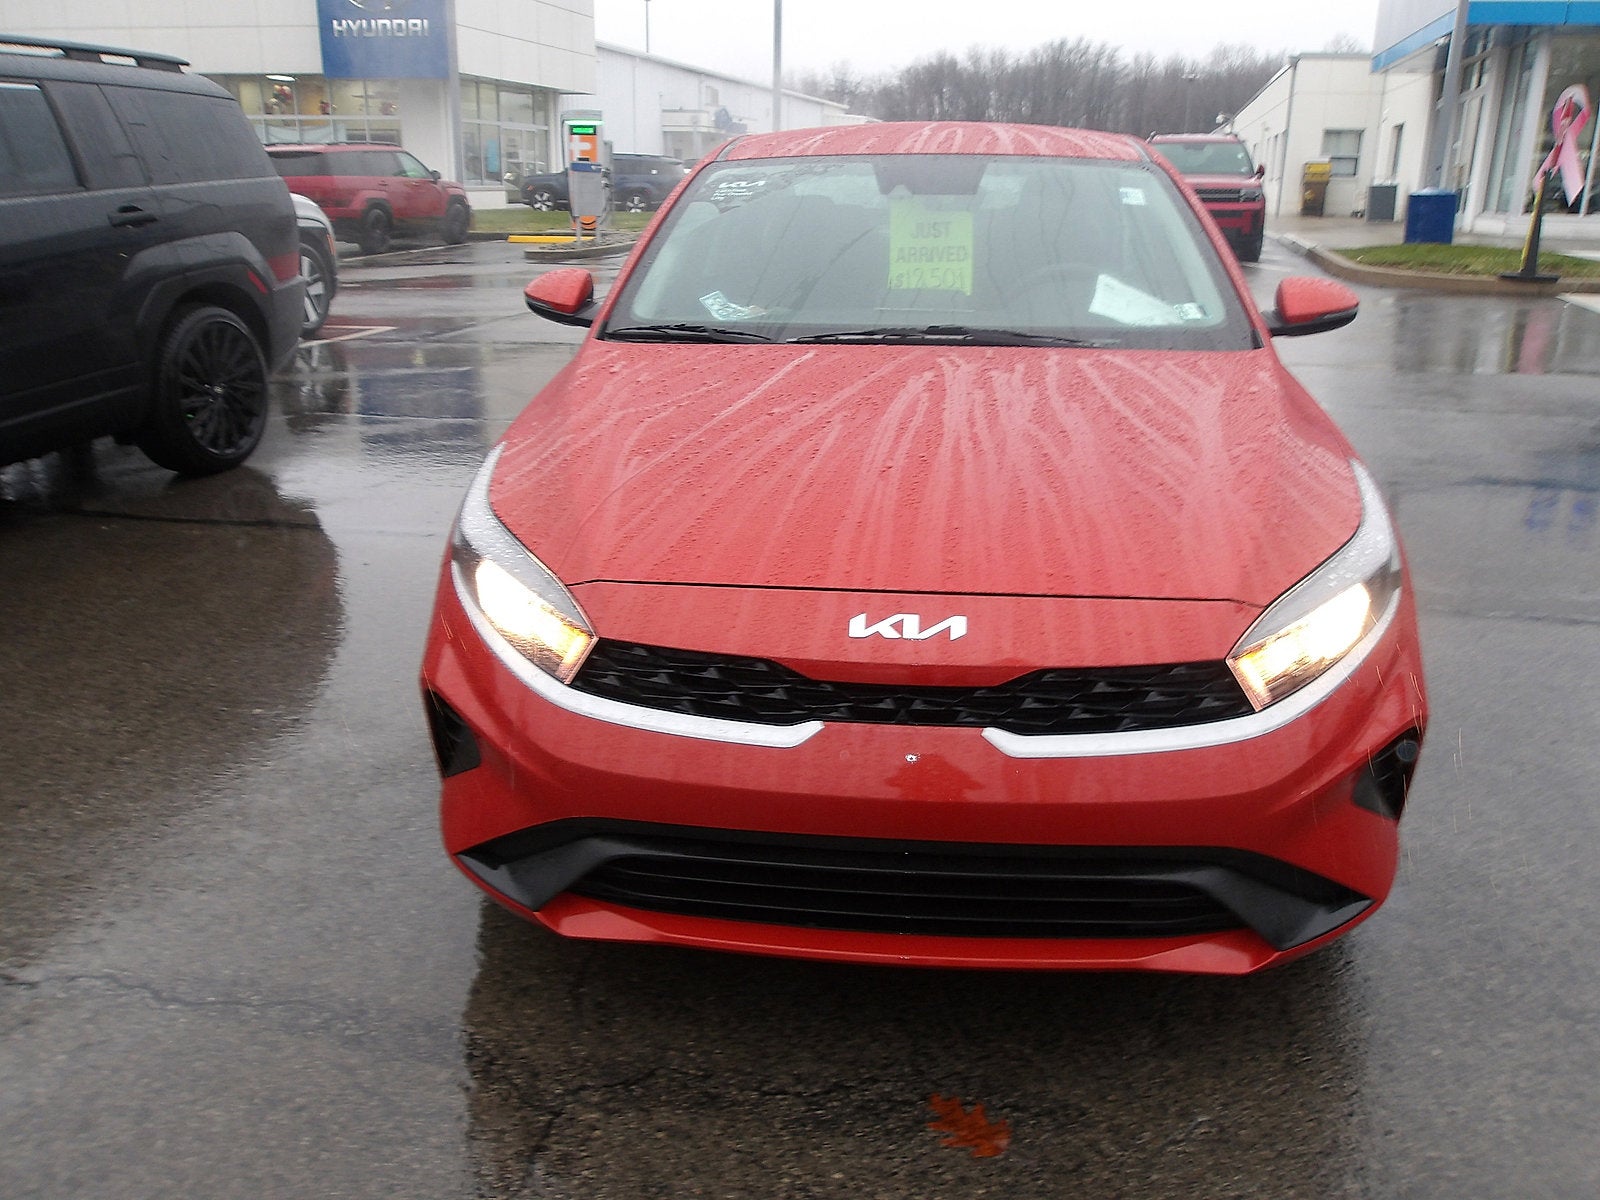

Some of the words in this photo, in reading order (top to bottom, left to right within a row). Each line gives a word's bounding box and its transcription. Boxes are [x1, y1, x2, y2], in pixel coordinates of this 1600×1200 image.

[332, 18, 430, 37] HYUNDAI
[910, 221, 951, 239] JUST
[895, 245, 969, 264] ARRIVED
[848, 612, 967, 641] KIA
